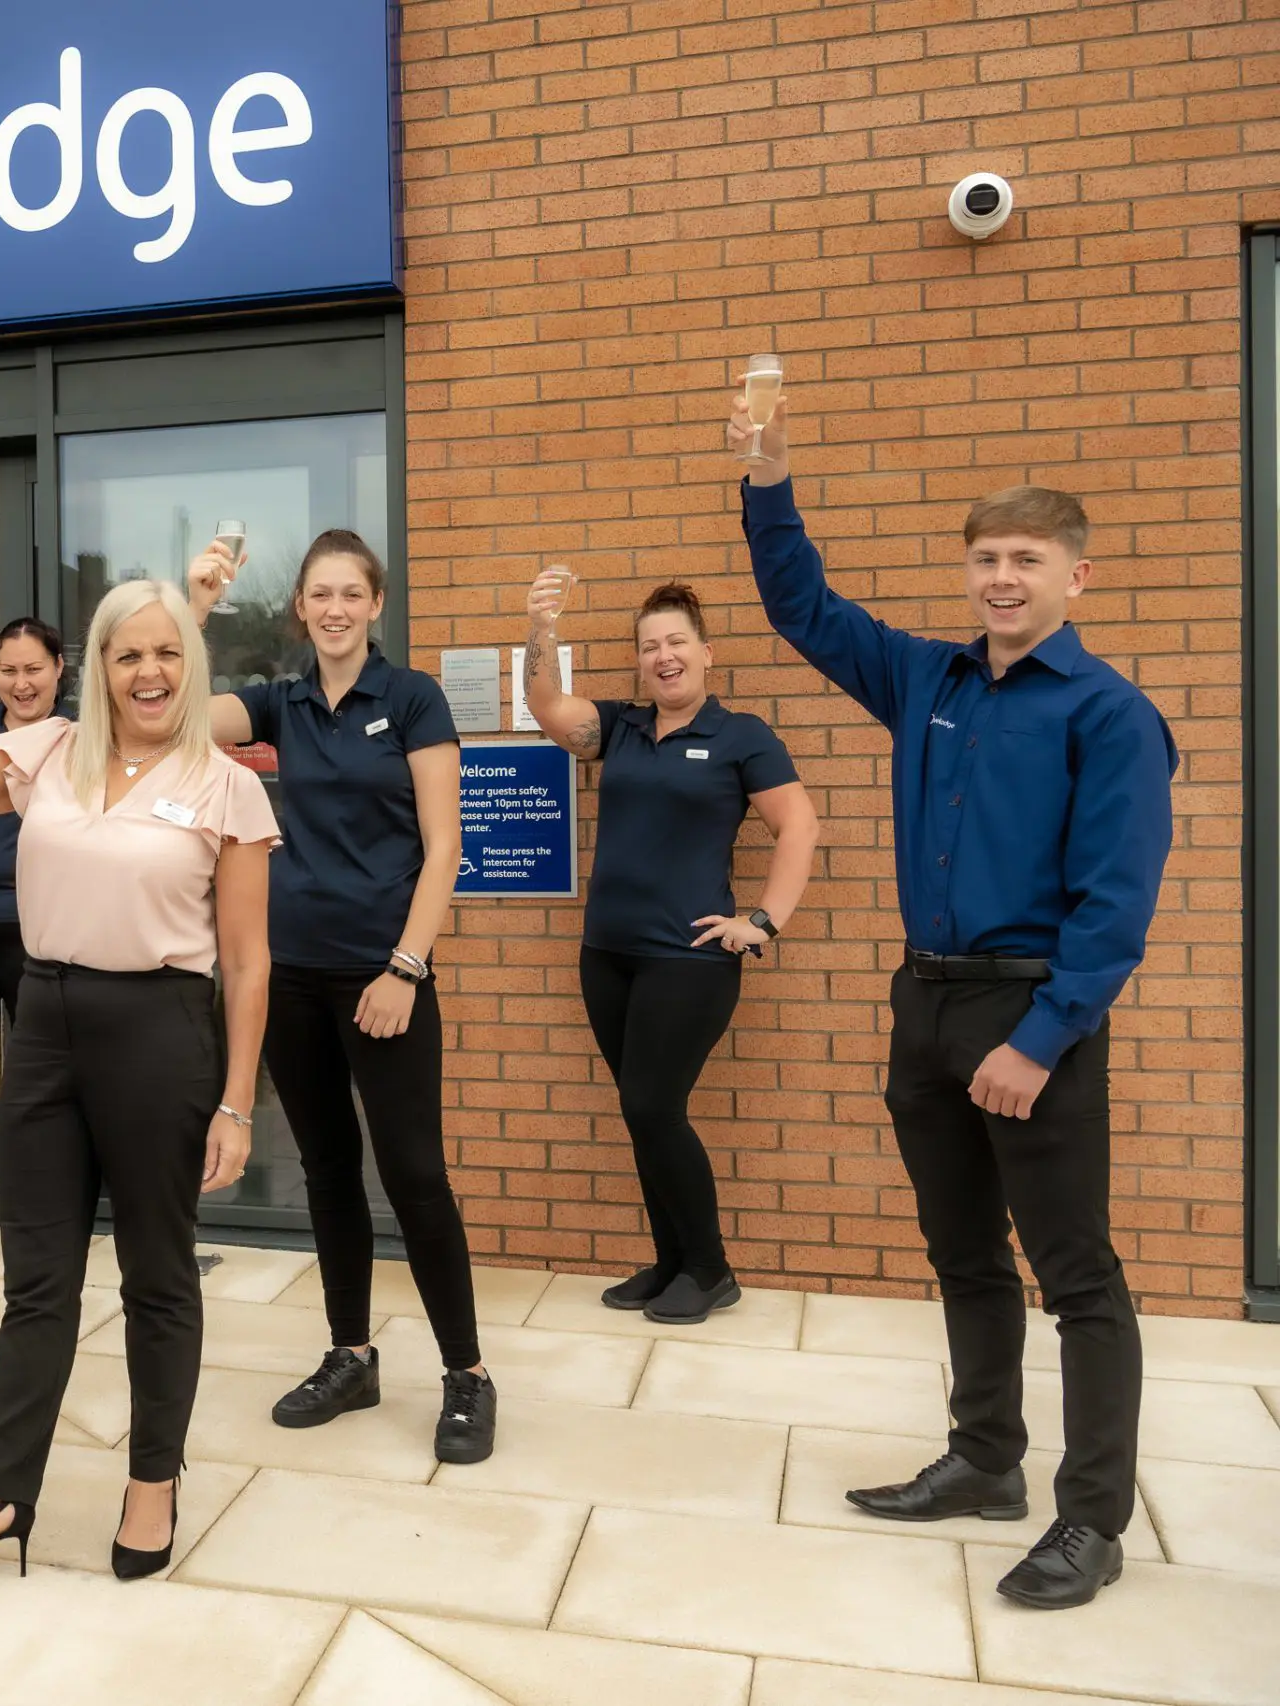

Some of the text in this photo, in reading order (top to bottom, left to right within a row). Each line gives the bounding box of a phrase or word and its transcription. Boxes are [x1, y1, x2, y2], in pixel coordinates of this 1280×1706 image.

[459, 786, 548, 797] or our guests safety
[459, 798, 557, 809] etween 10pm to 6am
[461, 810, 561, 822] ease use your keycard
[465, 824, 492, 832] enter.
[482, 847, 552, 857] Please press the
[483, 858, 536, 867] intercom for
[483, 869, 530, 878] assistance.
